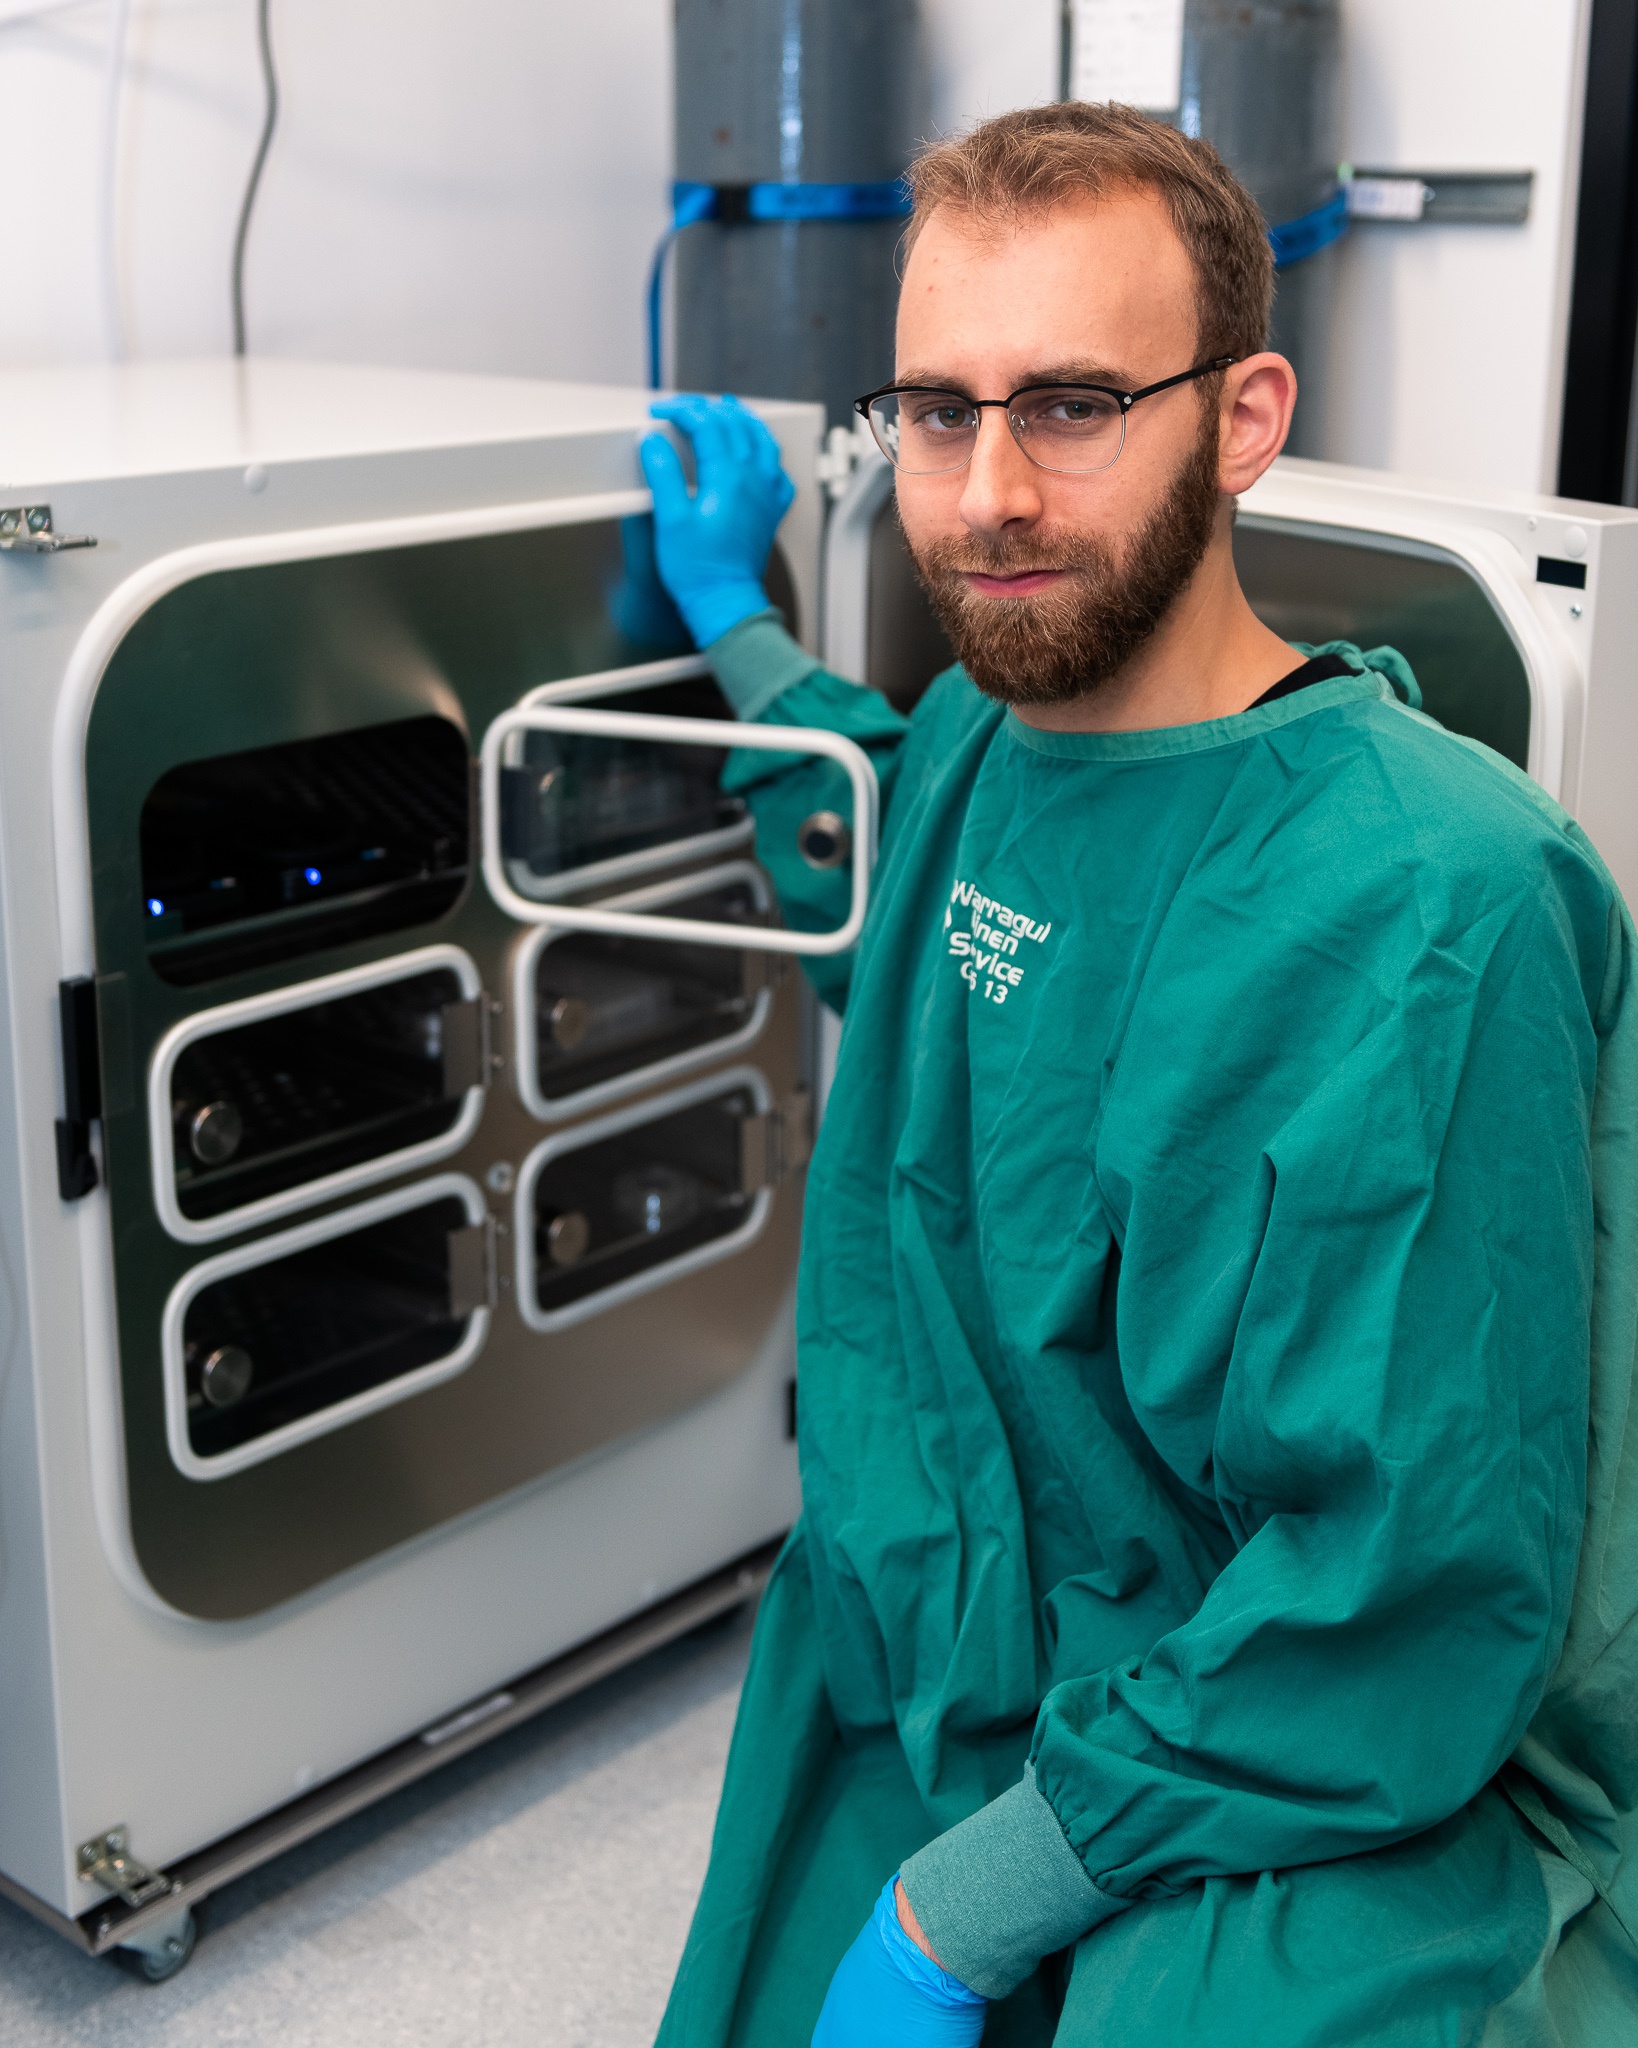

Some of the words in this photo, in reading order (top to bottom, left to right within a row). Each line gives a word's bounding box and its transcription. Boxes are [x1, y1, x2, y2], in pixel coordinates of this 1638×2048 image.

[950, 879, 1051, 943] Warragul
[949, 932, 1024, 986] Svice
[984, 980, 1008, 1004] 13
